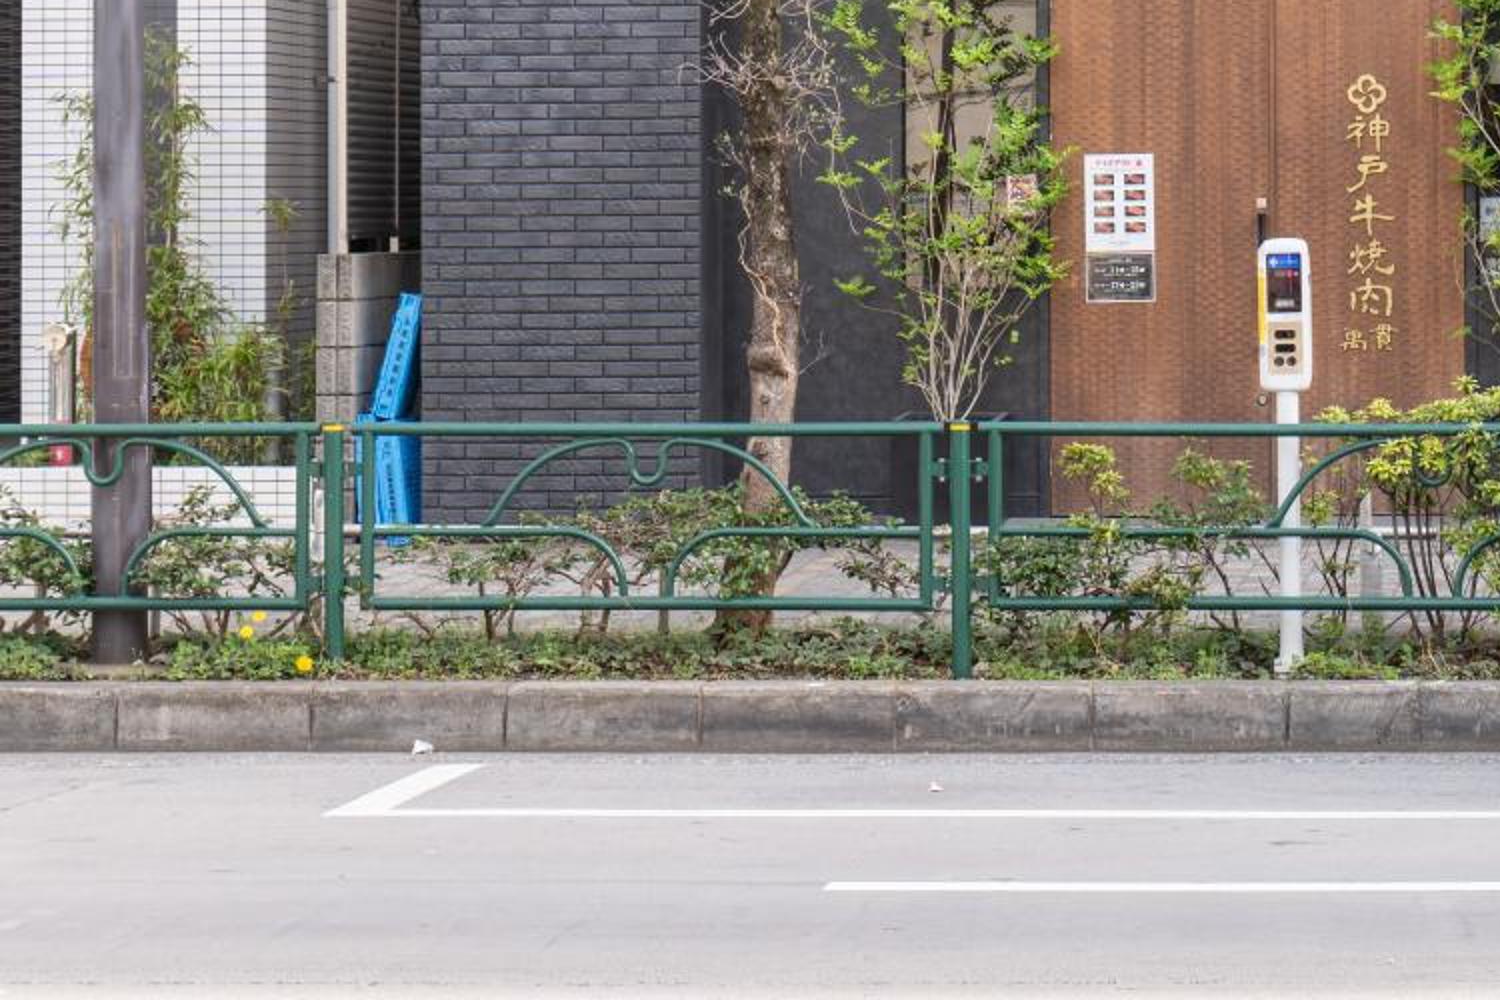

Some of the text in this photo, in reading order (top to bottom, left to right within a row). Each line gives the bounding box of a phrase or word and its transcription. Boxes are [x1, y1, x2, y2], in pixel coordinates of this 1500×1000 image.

[1346, 114, 1395, 317] 神戸牛焼肉
